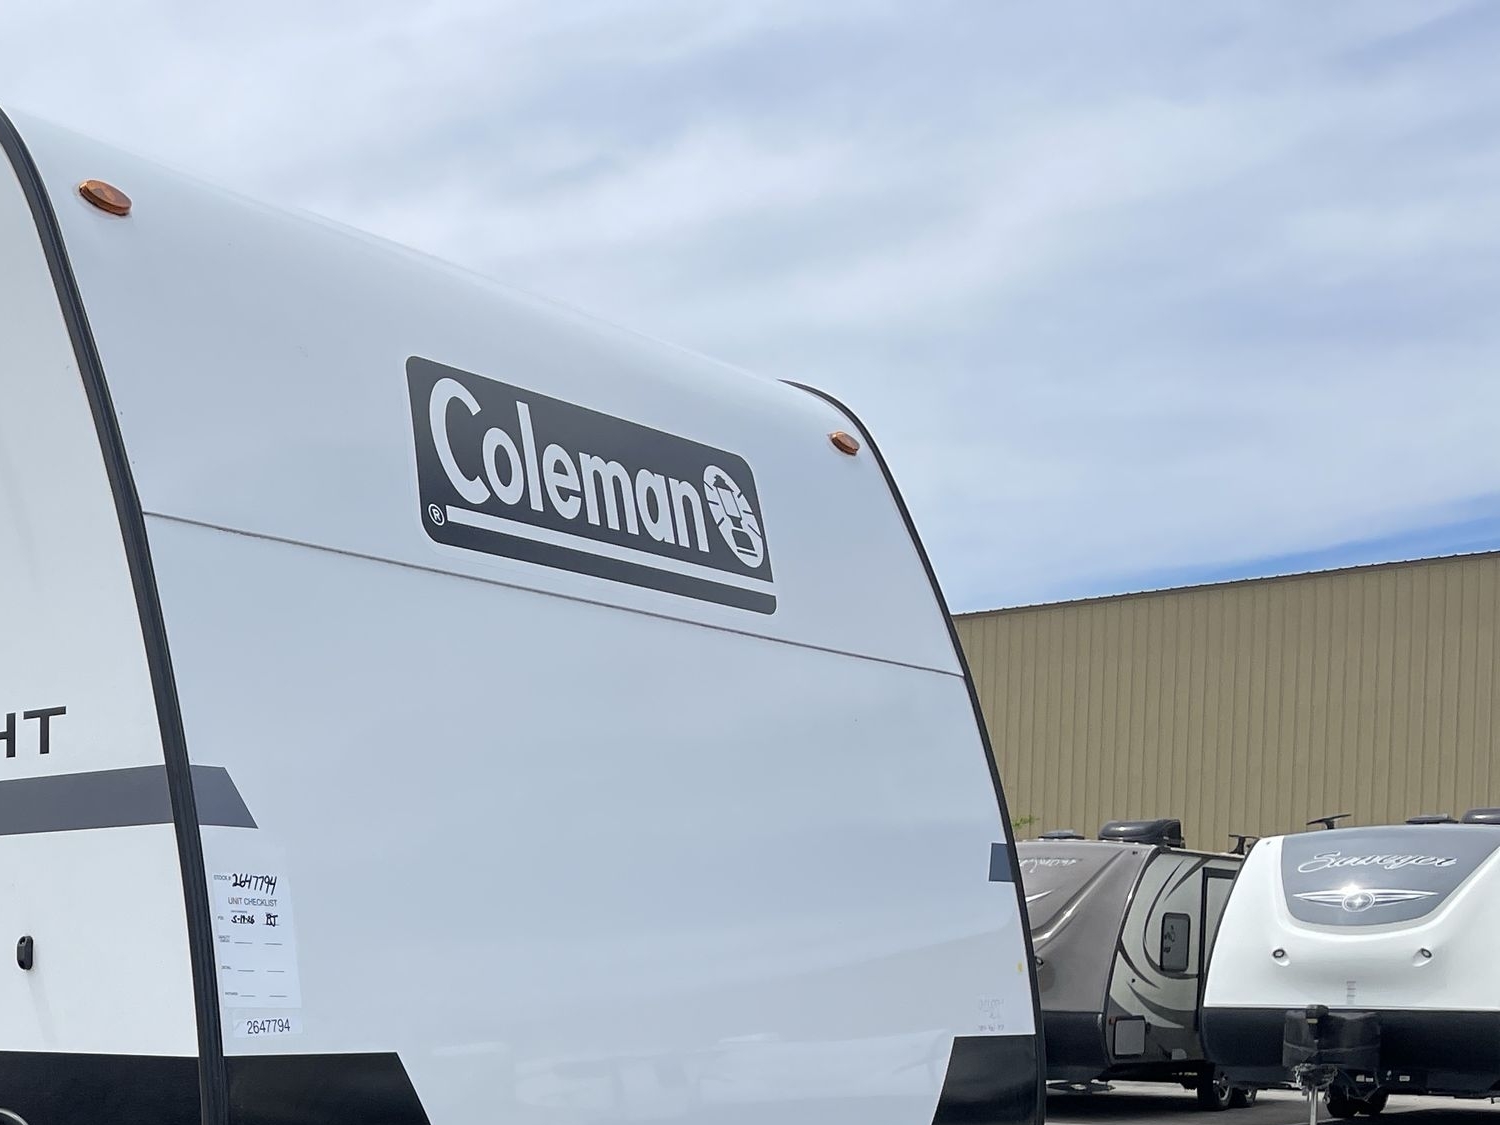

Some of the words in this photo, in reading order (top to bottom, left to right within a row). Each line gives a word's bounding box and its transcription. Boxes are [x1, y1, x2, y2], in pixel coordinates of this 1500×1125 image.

[429, 377, 710, 553] Coleman
[232, 873, 277, 896] 2647794
[228, 897, 242, 905] UNIT
[243, 898, 278, 907] CHECKLIST
[246, 1018, 291, 1035] 2647794
